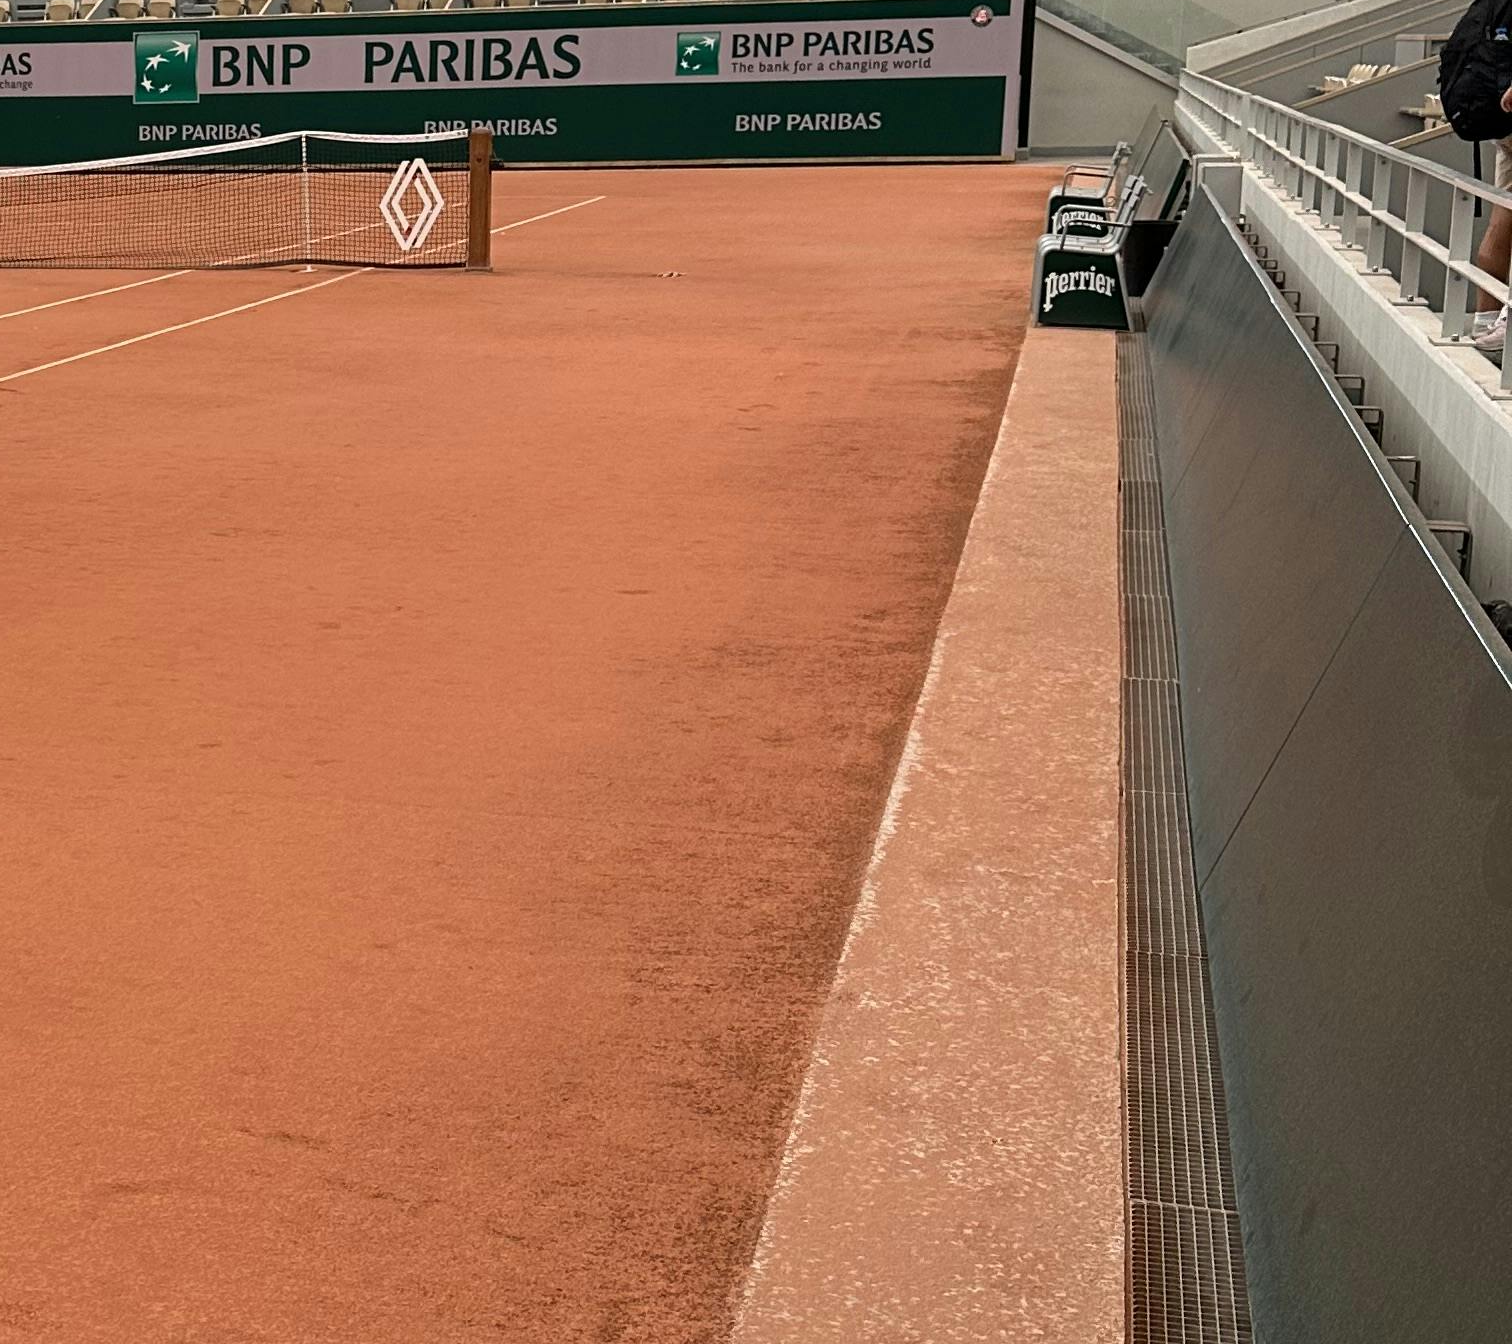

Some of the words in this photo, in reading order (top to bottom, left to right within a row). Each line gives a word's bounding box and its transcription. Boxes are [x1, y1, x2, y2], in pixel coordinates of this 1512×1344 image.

[731, 33, 794, 58] BNP
[803, 28, 934, 56] PARIBAS
[211, 43, 311, 87] BNP
[364, 34, 581, 83] PARIBAS
[731, 62, 754, 73] The
[759, 60, 789, 72] bank
[793, 60, 813, 74] for
[817, 62, 824, 71] a
[829, 58, 888, 73] changing
[892, 57, 931, 69] world
[0, 79, 33, 91] change
[735, 113, 781, 132] BNP
[786, 112, 881, 131] PARIBAS
[139, 125, 177, 141] BNP
[182, 123, 262, 141] PARIBAS
